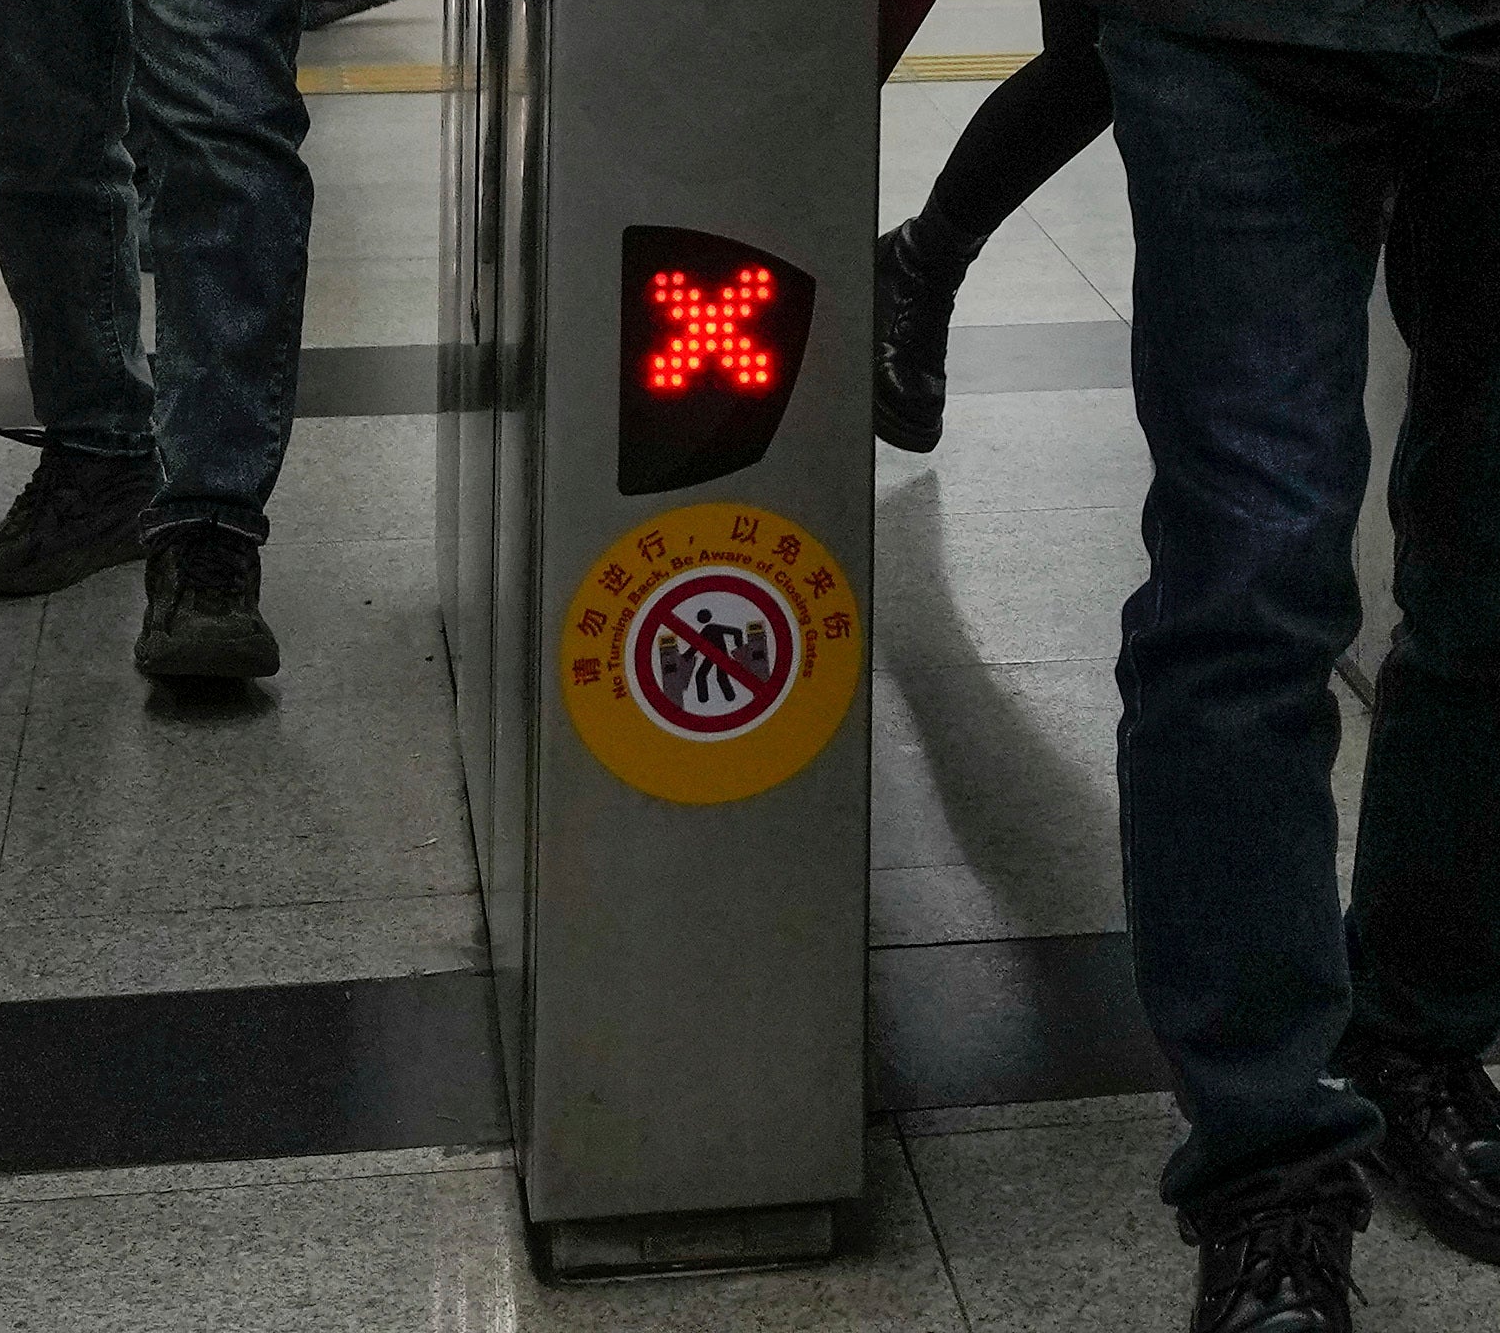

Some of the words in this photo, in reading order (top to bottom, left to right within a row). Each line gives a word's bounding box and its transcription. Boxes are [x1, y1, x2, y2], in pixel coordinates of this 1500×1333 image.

[606, 607, 637, 672] Turning
[698, 549, 753, 565] Aware
[756, 560, 774, 575] of
[773, 570, 812, 625] Closing
[802, 630, 821, 679] Gates
